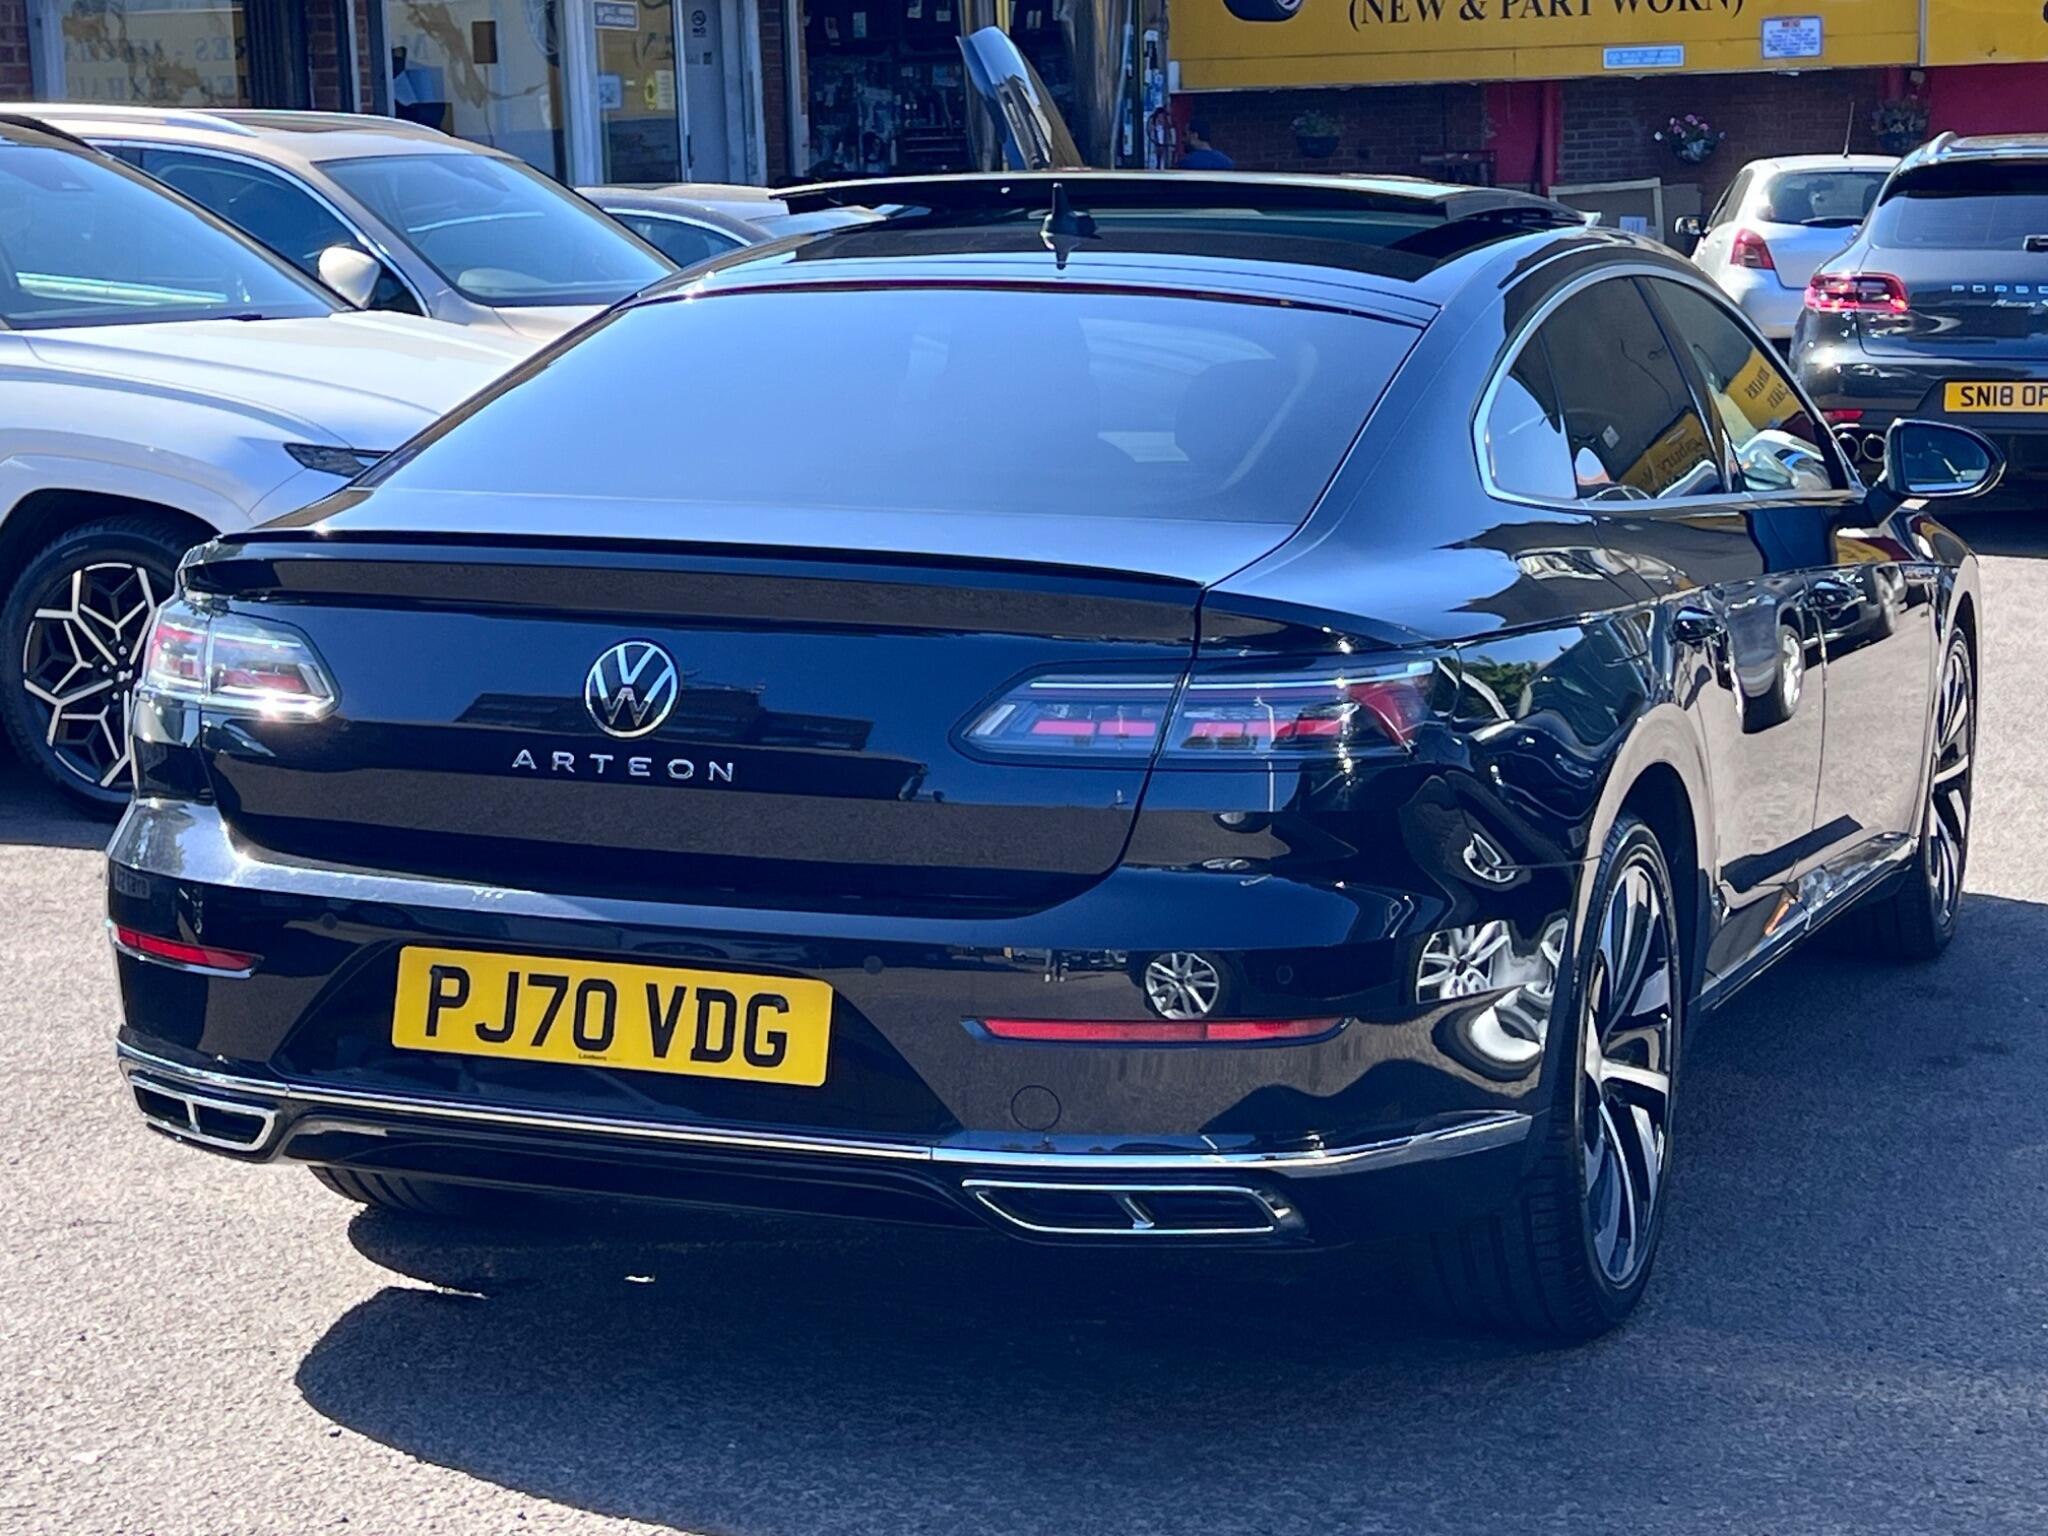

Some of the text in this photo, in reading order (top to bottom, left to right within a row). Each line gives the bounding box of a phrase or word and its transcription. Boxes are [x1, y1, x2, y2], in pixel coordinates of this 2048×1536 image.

[1459, 0, 1488, 21] &
[1960, 385, 2013, 407] SN18
[511, 749, 734, 783] ARTEON
[424, 964, 790, 1069] PJ70 VDG
